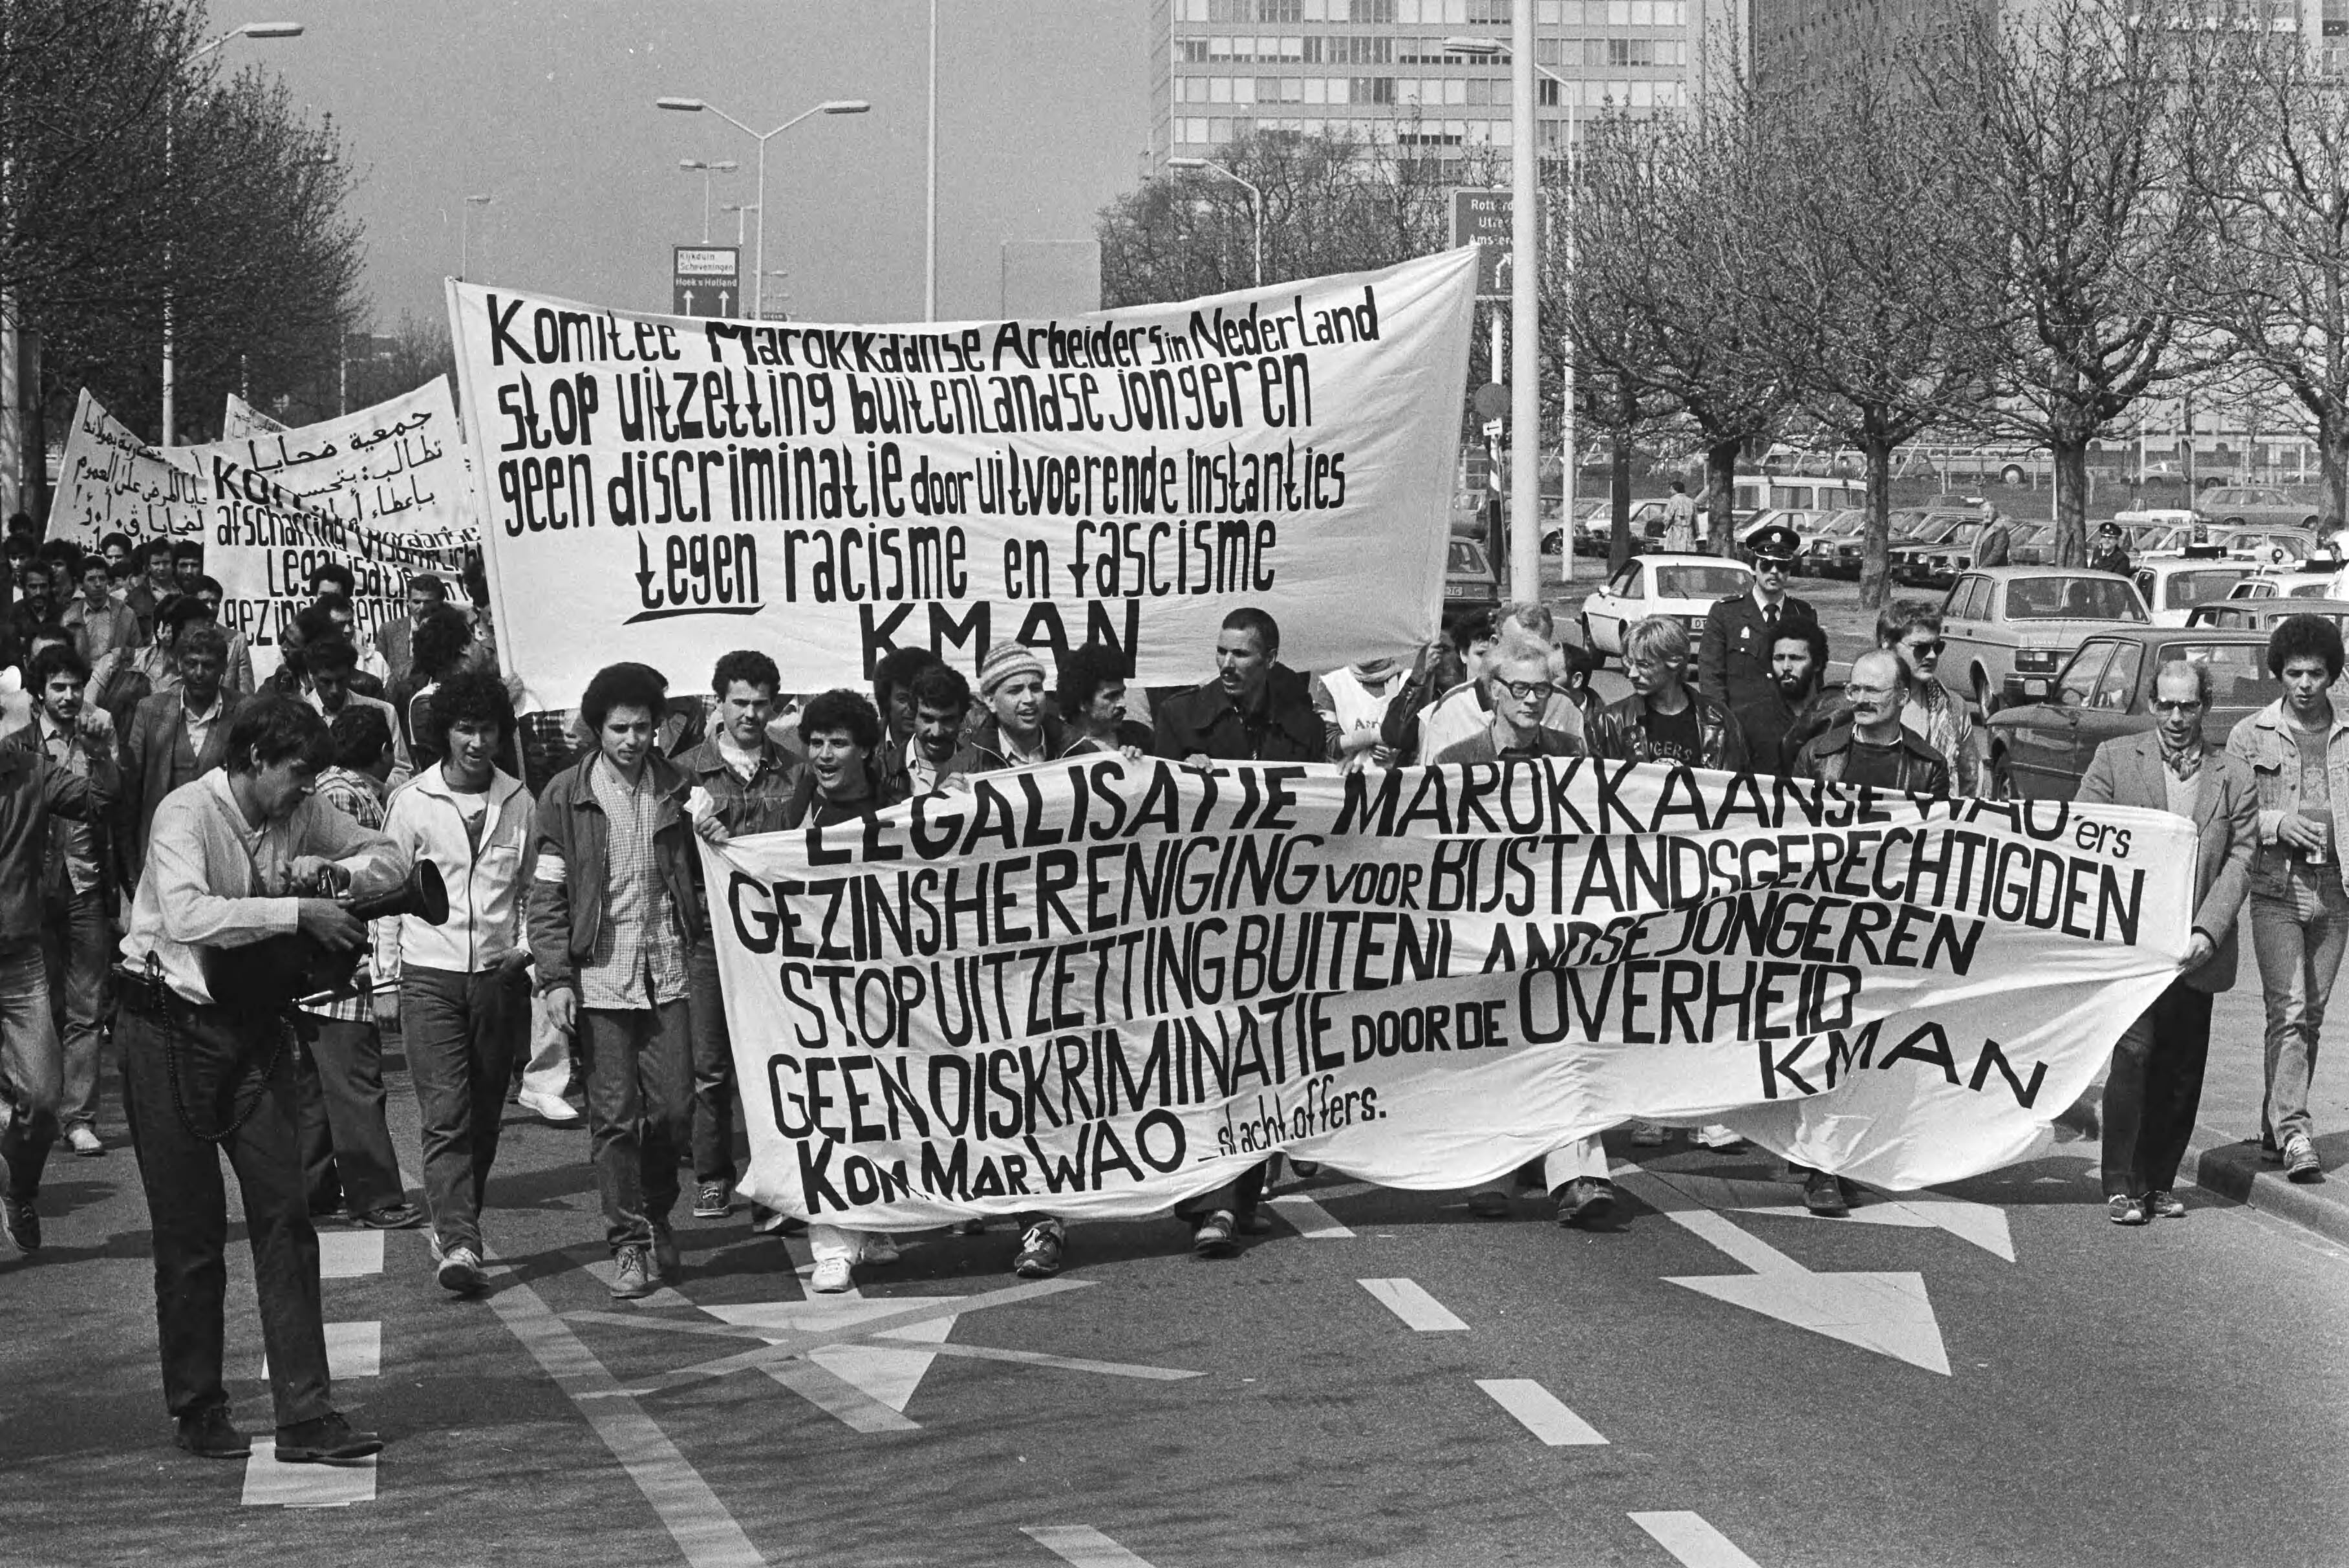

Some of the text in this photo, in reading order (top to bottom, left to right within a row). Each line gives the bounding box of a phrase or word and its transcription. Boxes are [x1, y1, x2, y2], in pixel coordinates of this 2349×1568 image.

[704, 277, 737, 287] Holland
[487, 294, 680, 366] Komitee
[705, 321, 985, 373] Marokkaanse
[992, 320, 1164, 372] Arbeiders
[1164, 332, 1192, 363] in
[616, 365, 836, 443] uitzetting
[1108, 352, 1313, 433] jongeren
[497, 435, 1346, 538] geen discriminatie door uitvoerende instanties
[634, 519, 1276, 610] tegen racisme en fascisme
[859, 599, 1140, 681] KMAN
[806, 760, 1307, 867] LEGALISATIE
[1331, 755, 1892, 838] MAROKKAANSE
[727, 827, 2146, 962] GEZINSHERENIGING VOOR BIJSTANDSGERECHTIGDEN
[779, 962, 927, 1049] STOP
[930, 916, 1229, 1048] UITZETTING
[1653, 890, 1986, 976] JONGEREN
[766, 960, 1863, 1143] GEEN DISKRIMINATIE DOOR DE OVERHEID
[1758, 1018, 2049, 1110] KMAN
